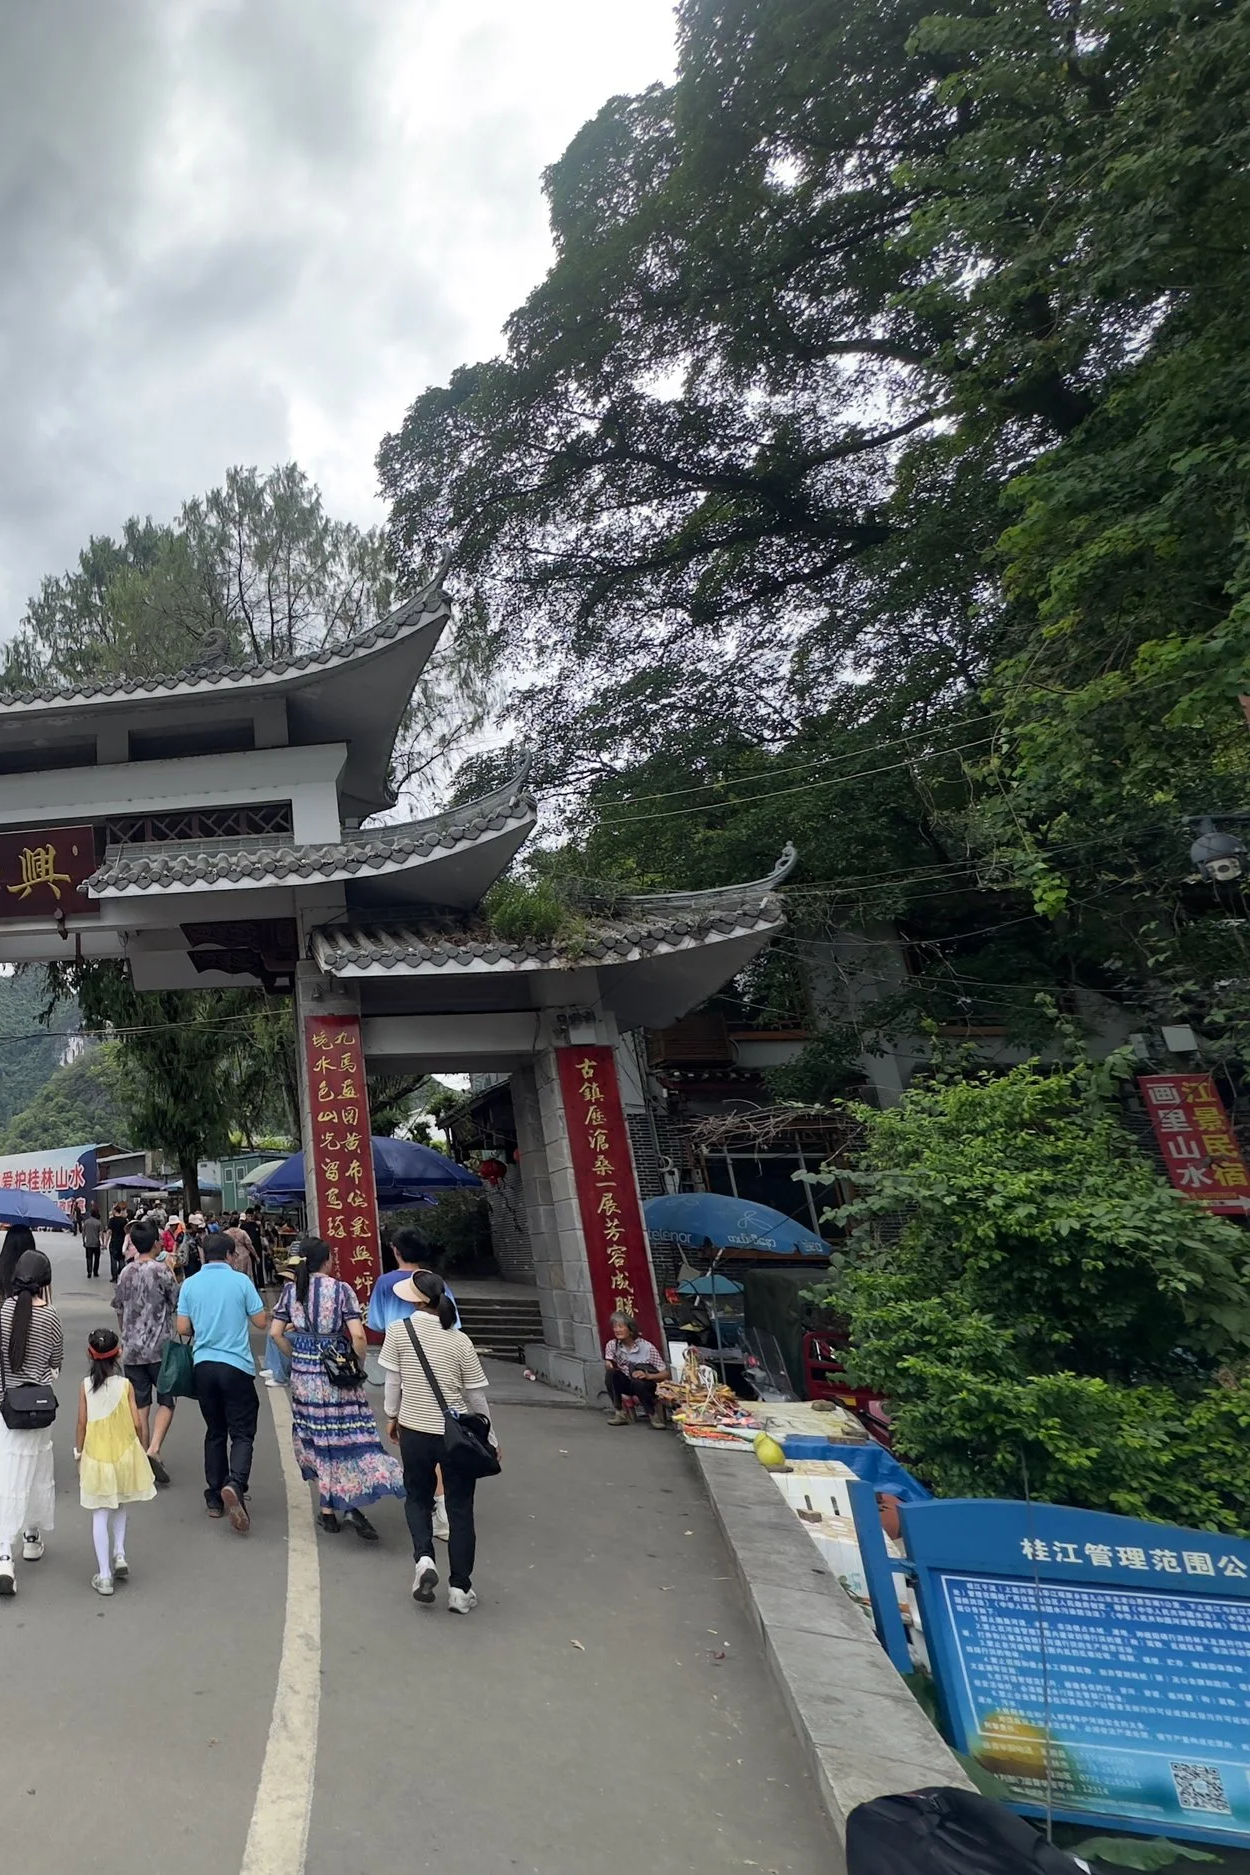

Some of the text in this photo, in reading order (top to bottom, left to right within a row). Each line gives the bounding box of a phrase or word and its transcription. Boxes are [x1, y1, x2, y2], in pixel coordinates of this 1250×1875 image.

[1146, 1083, 1213, 1188] 画里山水
[1181, 1081, 1249, 1187] 江景民宿
[647, 1228, 693, 1243] telenor
[1019, 1537, 1249, 1578] 桂江管理范围公
